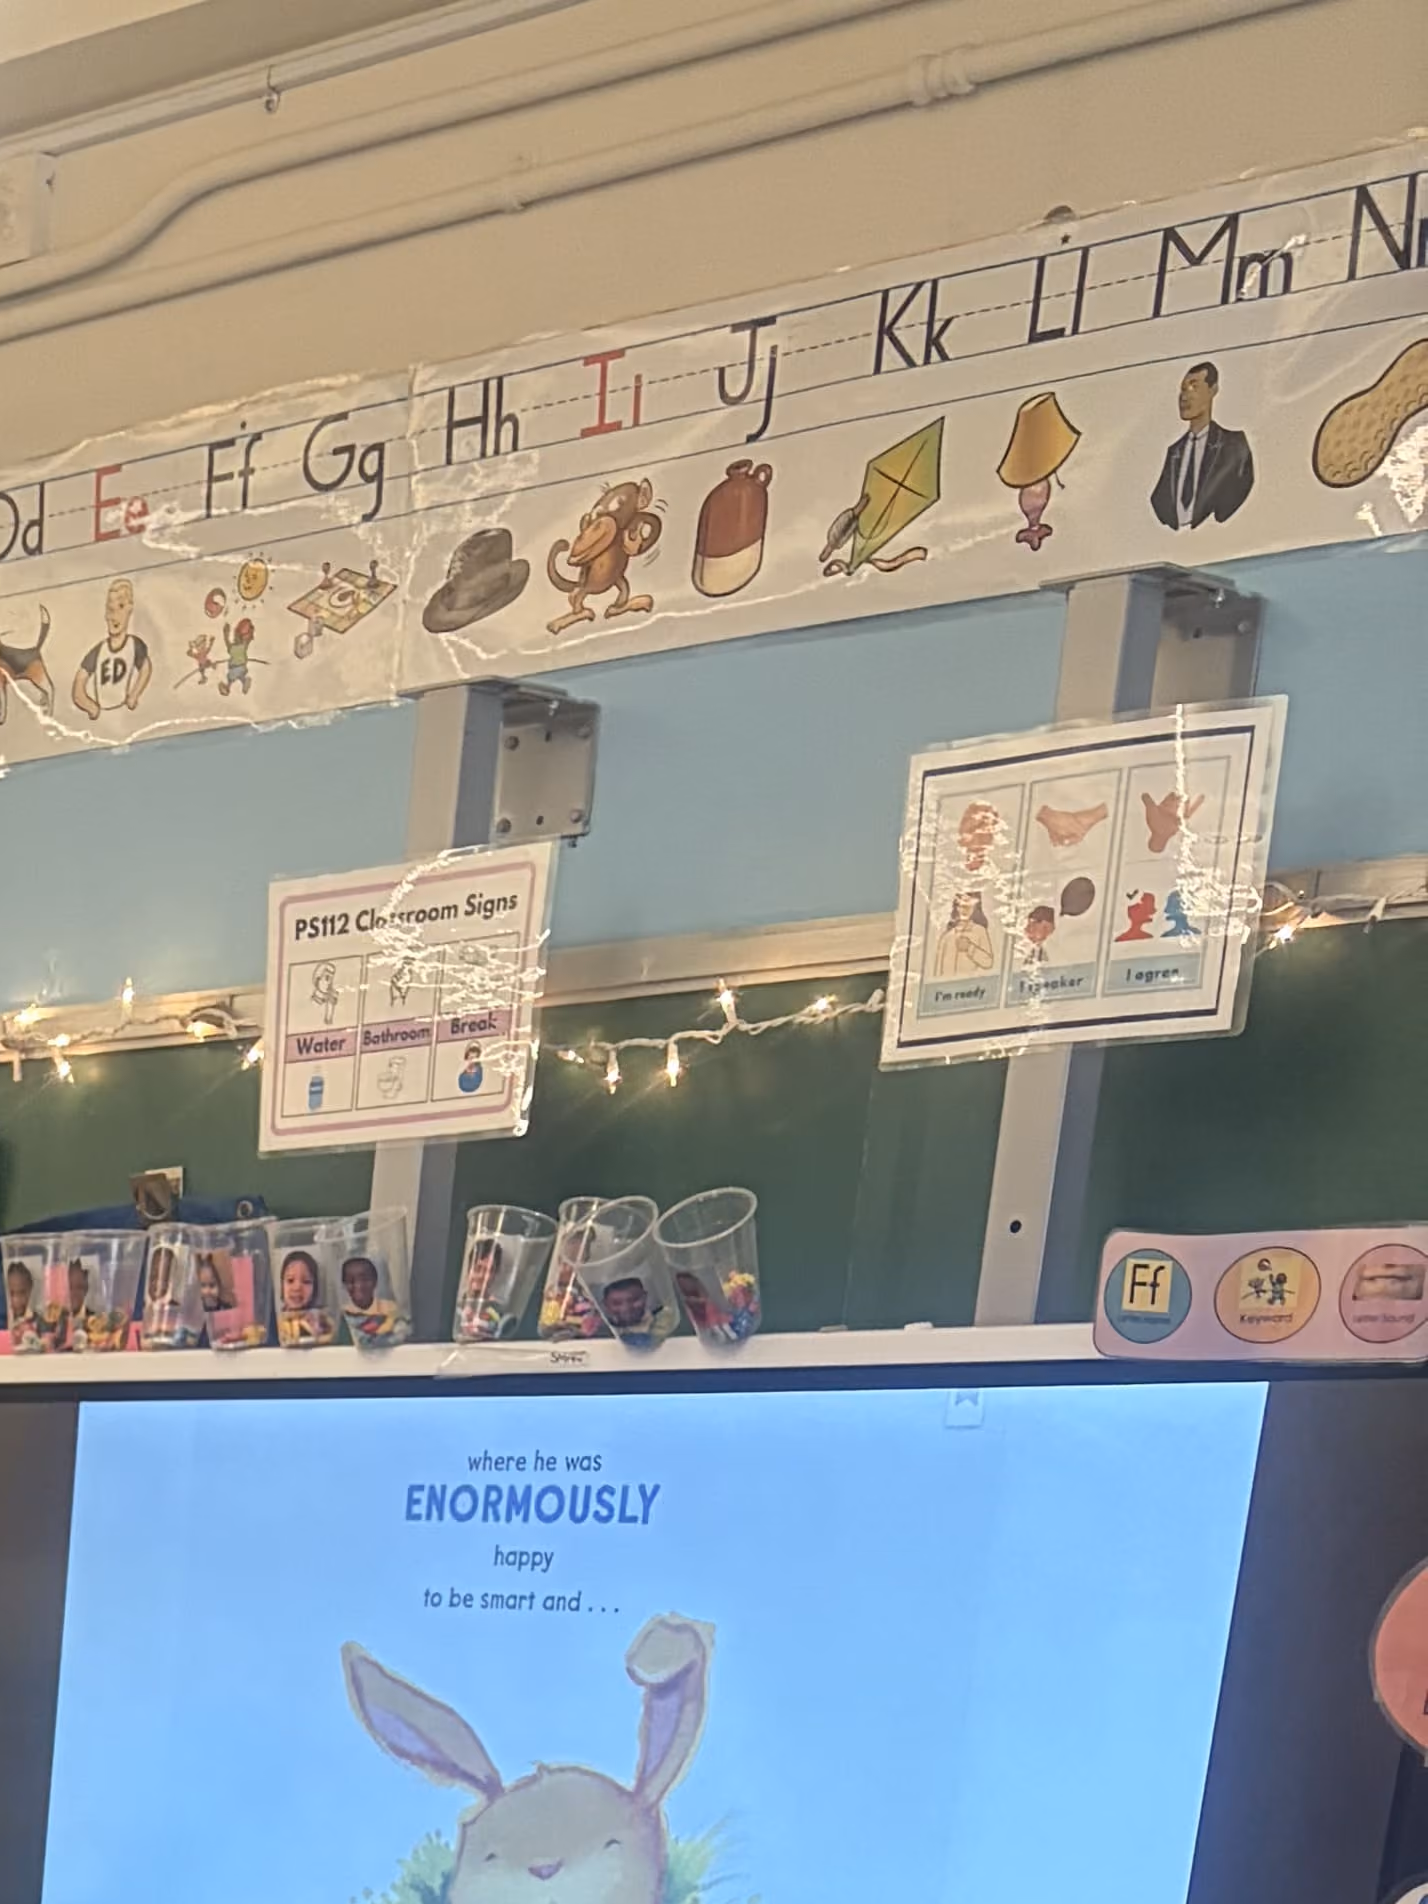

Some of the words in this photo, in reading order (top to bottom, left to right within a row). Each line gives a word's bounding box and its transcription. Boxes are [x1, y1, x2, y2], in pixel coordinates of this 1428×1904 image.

[92, 463, 151, 544] Ee
[206, 433, 262, 518] Ff
[303, 411, 385, 522] Gg
[444, 376, 522, 466] Hh
[579, 350, 643, 438] Ii
[717, 316, 780, 444] Jj
[872, 277, 954, 376] Kk
[1026, 245, 1091, 345] Ll
[1153, 212, 1295, 319] Mm
[100, 660, 126, 688] ED
[295, 913, 349, 940] PS112
[464, 893, 518, 919] Signs
[363, 1026, 430, 1046] Bathroom
[450, 1013, 496, 1035] Break
[296, 1037, 346, 1055] Water
[1128, 1264, 1165, 1305] Ff
[468, 1450, 526, 1471] where
[534, 1450, 557, 1471] he
[566, 1454, 602, 1471] was
[406, 1483, 661, 1524] ENORMOUSLY
[494, 1545, 553, 1572] happy
[423, 1588, 442, 1607] to
[448, 1587, 474, 1608] be
[481, 1591, 535, 1610] smart
[543, 1591, 582, 1612] and
